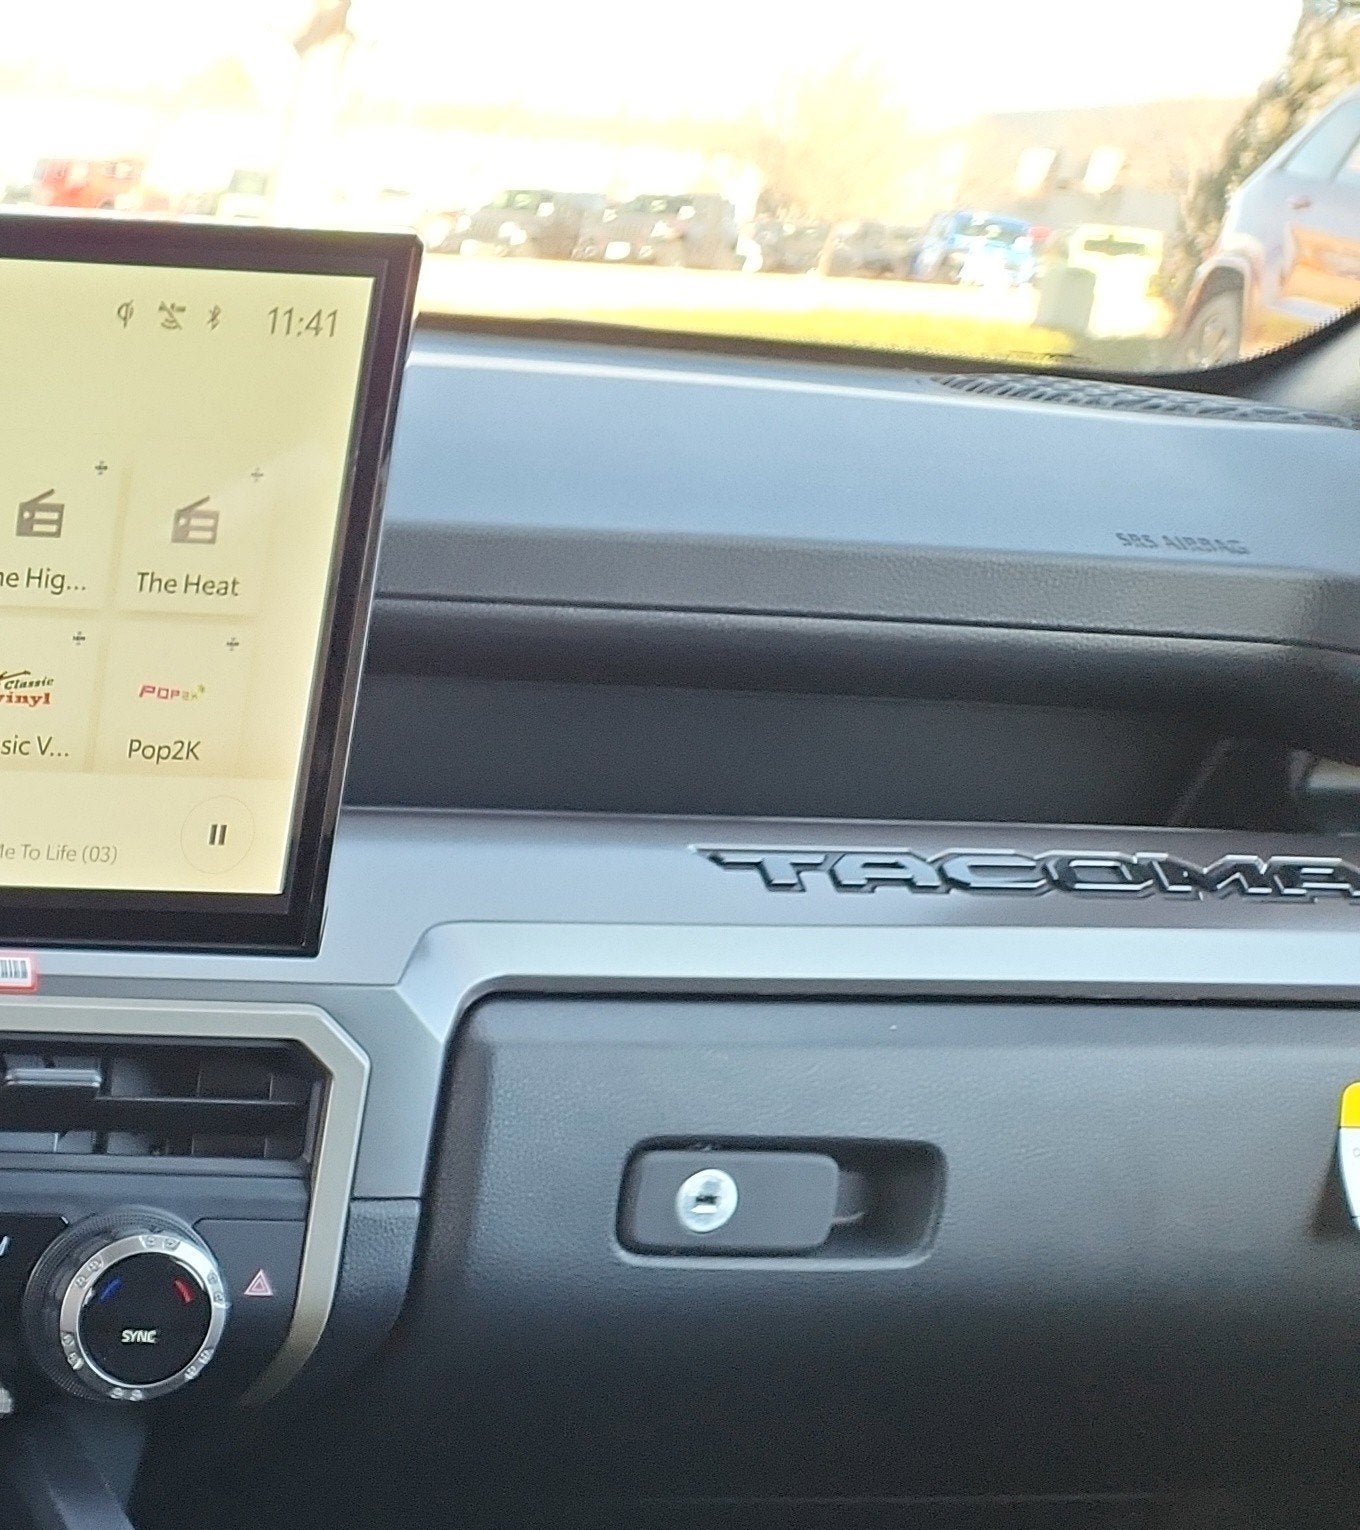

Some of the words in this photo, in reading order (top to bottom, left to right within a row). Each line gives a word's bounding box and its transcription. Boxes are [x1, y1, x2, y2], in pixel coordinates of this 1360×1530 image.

[268, 306, 338, 337] 11:41
[1115, 532, 1159, 549] SRS
[1161, 535, 1250, 555] AIRBAG
[23, 567, 87, 595] Hig...
[136, 572, 178, 595] The
[182, 573, 239, 597] Heat
[4, 676, 54, 690] Classic
[35, 736, 70, 758] V...
[128, 739, 201, 765] Pop2K
[21, 843, 42, 861] To
[47, 844, 77, 862] Life
[82, 844, 118, 865] (03)
[688, 843, 1360, 902] TACOMA
[121, 1329, 157, 1344] SYNC
